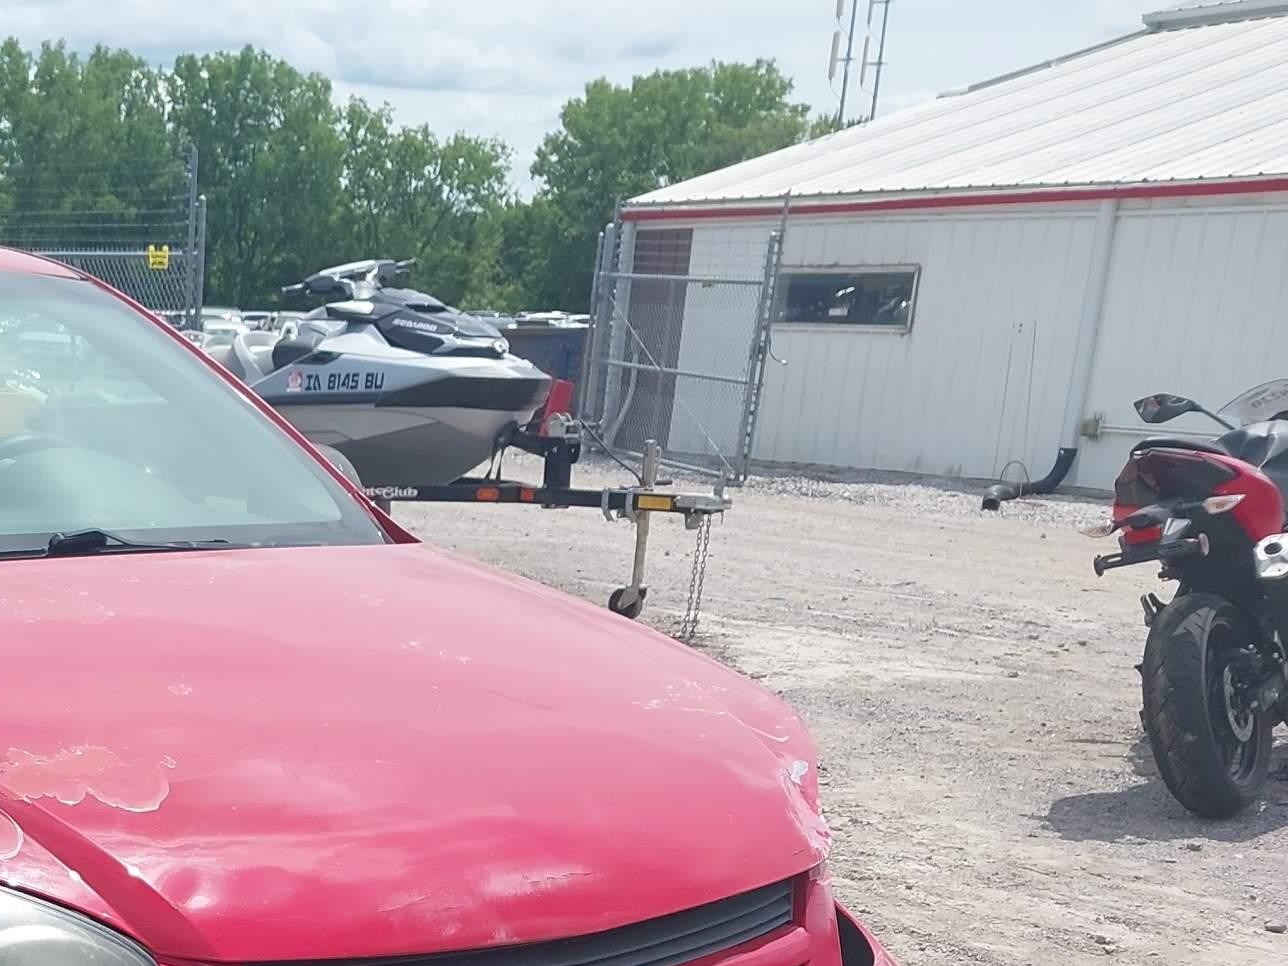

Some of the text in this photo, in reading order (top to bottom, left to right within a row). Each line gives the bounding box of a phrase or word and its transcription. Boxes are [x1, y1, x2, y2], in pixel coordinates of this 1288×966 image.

[305, 372, 385, 391] IA 8145 BU
